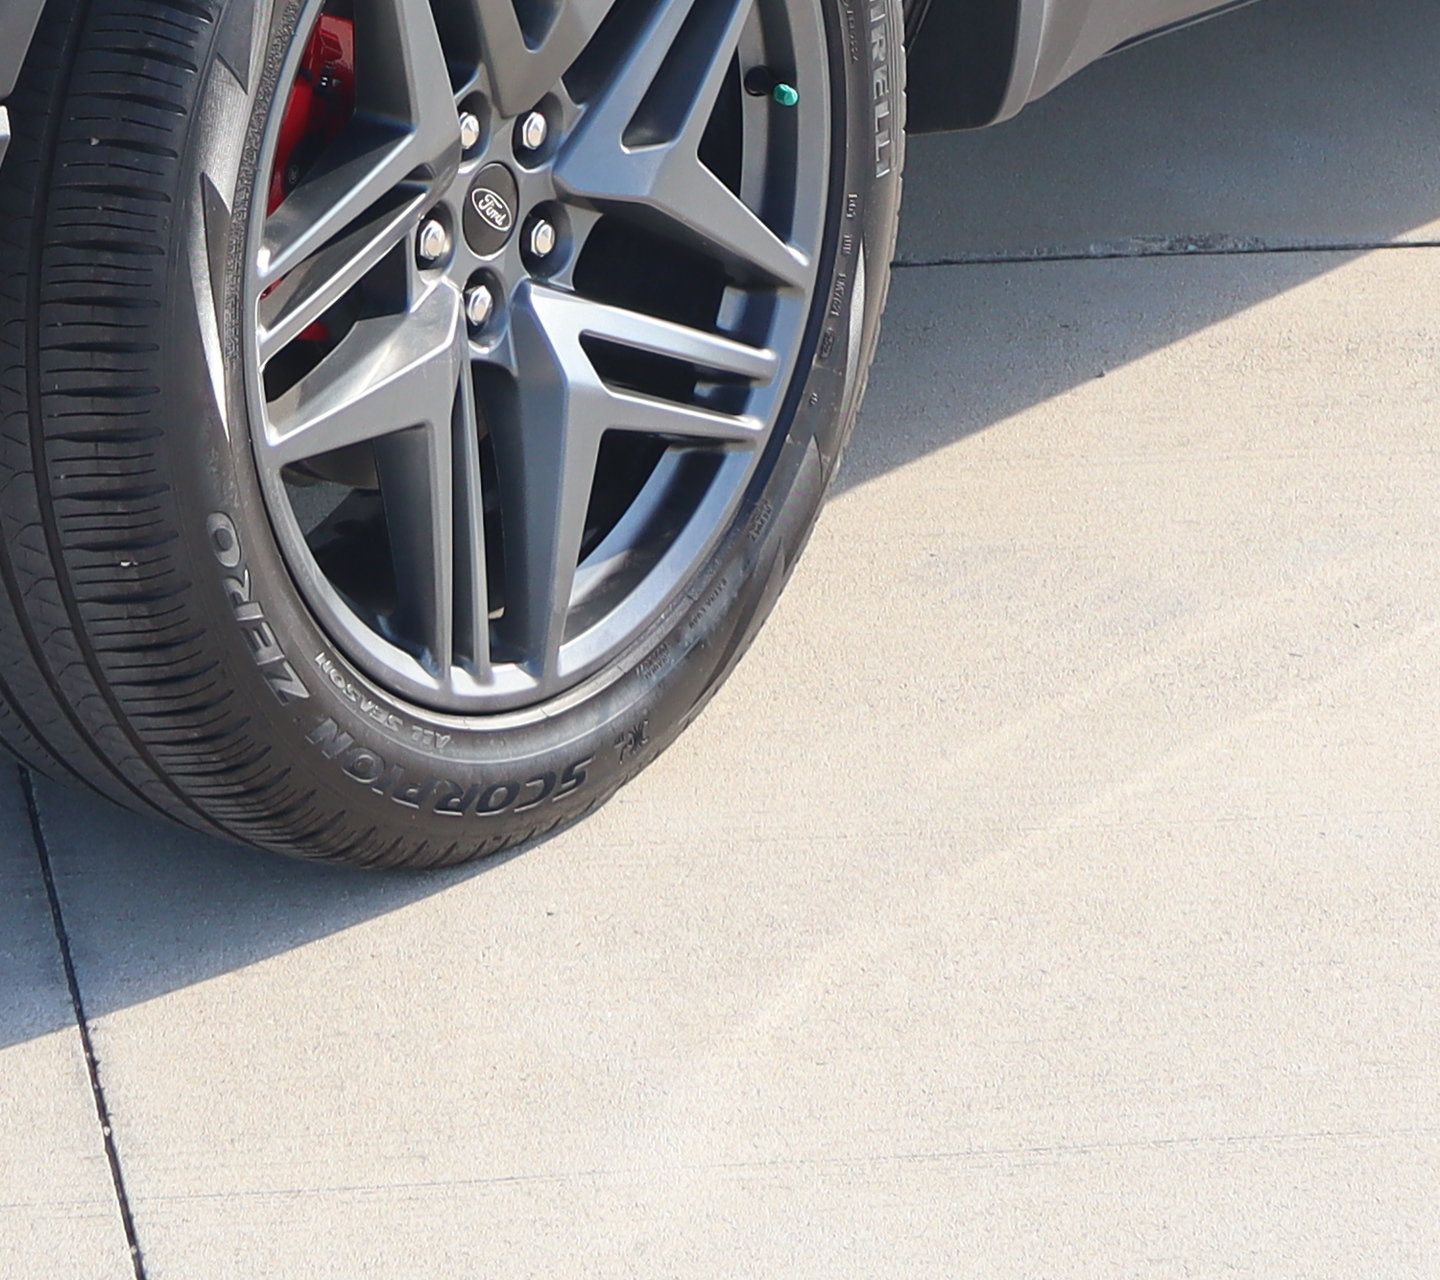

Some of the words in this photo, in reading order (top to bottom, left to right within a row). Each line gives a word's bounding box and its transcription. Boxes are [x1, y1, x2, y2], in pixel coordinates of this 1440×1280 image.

[207, 512, 312, 708] ZERO
[314, 651, 406, 733] SEASON
[398, 718, 454, 752] ALL
[304, 718, 592, 818] SCORPION
